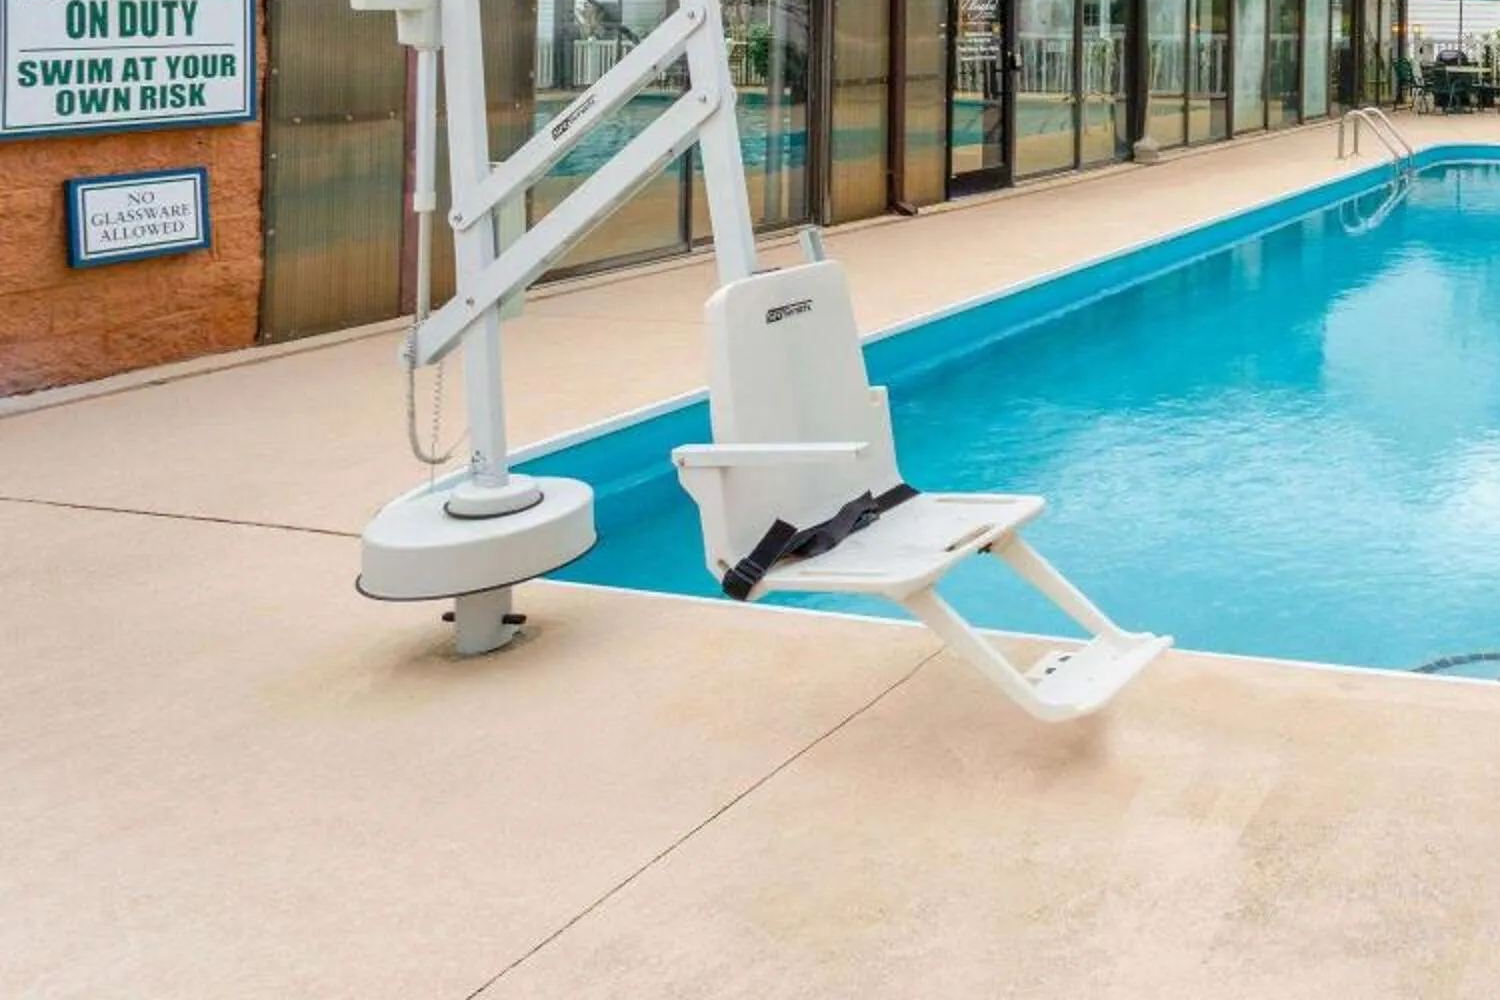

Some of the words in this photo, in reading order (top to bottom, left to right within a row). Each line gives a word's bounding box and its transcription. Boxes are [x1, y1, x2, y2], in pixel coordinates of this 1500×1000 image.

[66, 0, 109, 39] ON
[118, 0, 198, 37] DUTY
[17, 57, 113, 88] SWIM
[121, 56, 157, 82] AT
[166, 53, 236, 80] YOUR
[55, 86, 131, 117] OWN
[139, 83, 206, 111] RISK
[127, 190, 155, 205] NO
[91, 203, 192, 227] GLASSWARE
[100, 221, 186, 243] ALLOWED
